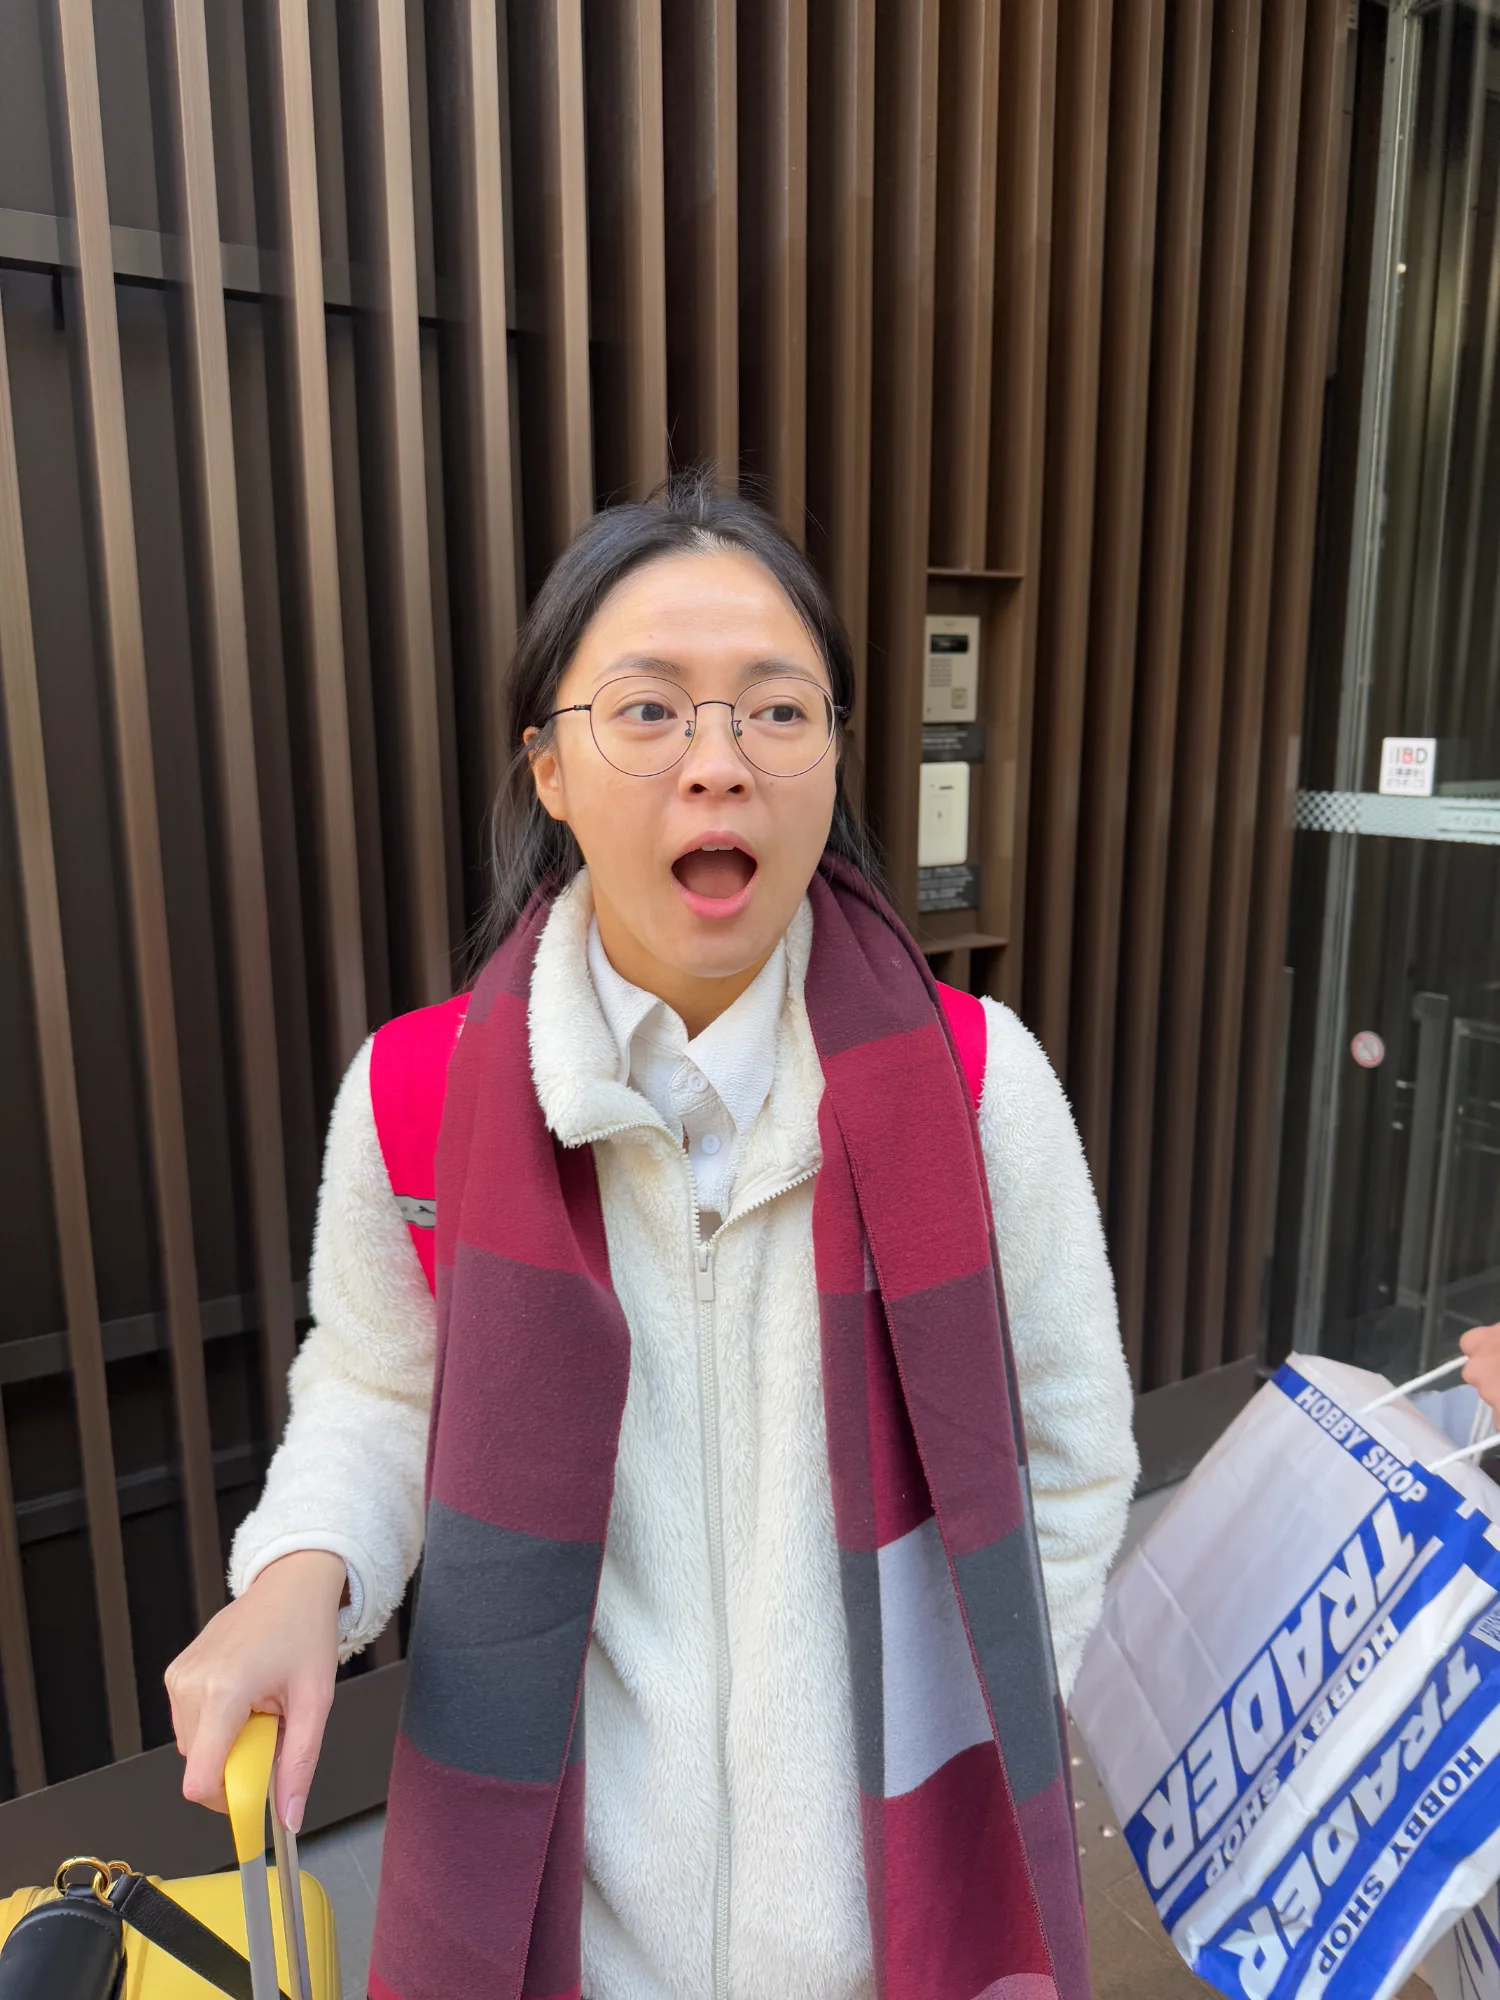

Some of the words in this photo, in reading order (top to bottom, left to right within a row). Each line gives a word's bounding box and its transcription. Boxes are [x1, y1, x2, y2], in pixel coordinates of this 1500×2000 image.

[1293, 1384, 1370, 1451] HOBBY
[1361, 1444, 1428, 1502] SHOP
[1141, 1497, 1416, 1891] TRADER
[1293, 1615, 1401, 1769] HOBBY
[1205, 1766, 1281, 1889] SHOP
[1220, 1645, 1483, 2000] TRADER
[1386, 1744, 1485, 1868] HOBBY
[1318, 1873, 1386, 1977] SHOP
